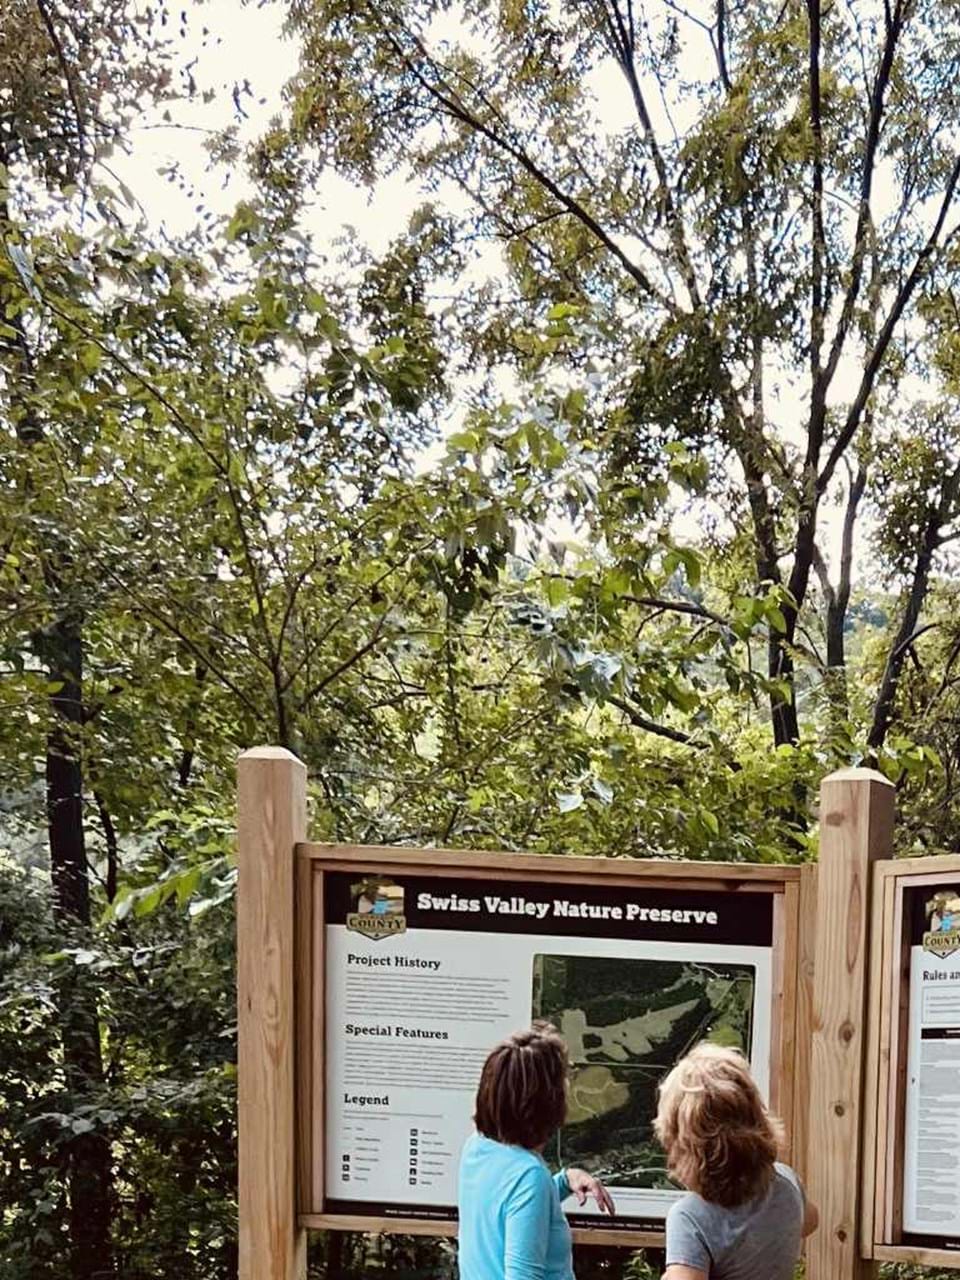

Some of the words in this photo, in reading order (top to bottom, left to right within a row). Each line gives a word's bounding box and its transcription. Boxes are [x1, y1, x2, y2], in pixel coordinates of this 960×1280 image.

[417, 893, 481, 912] Swiss
[484, 897, 550, 919] Valley
[553, 900, 622, 919] Nature
[625, 903, 718, 924] Preserve
[349, 918, 404, 929] COUNTY
[347, 954, 391, 967] Project
[394, 956, 441, 970] History
[922, 970, 947, 981] Rules
[345, 1024, 391, 1036] Special
[395, 1027, 449, 1039] Features
[344, 1093, 390, 1106] Legend
